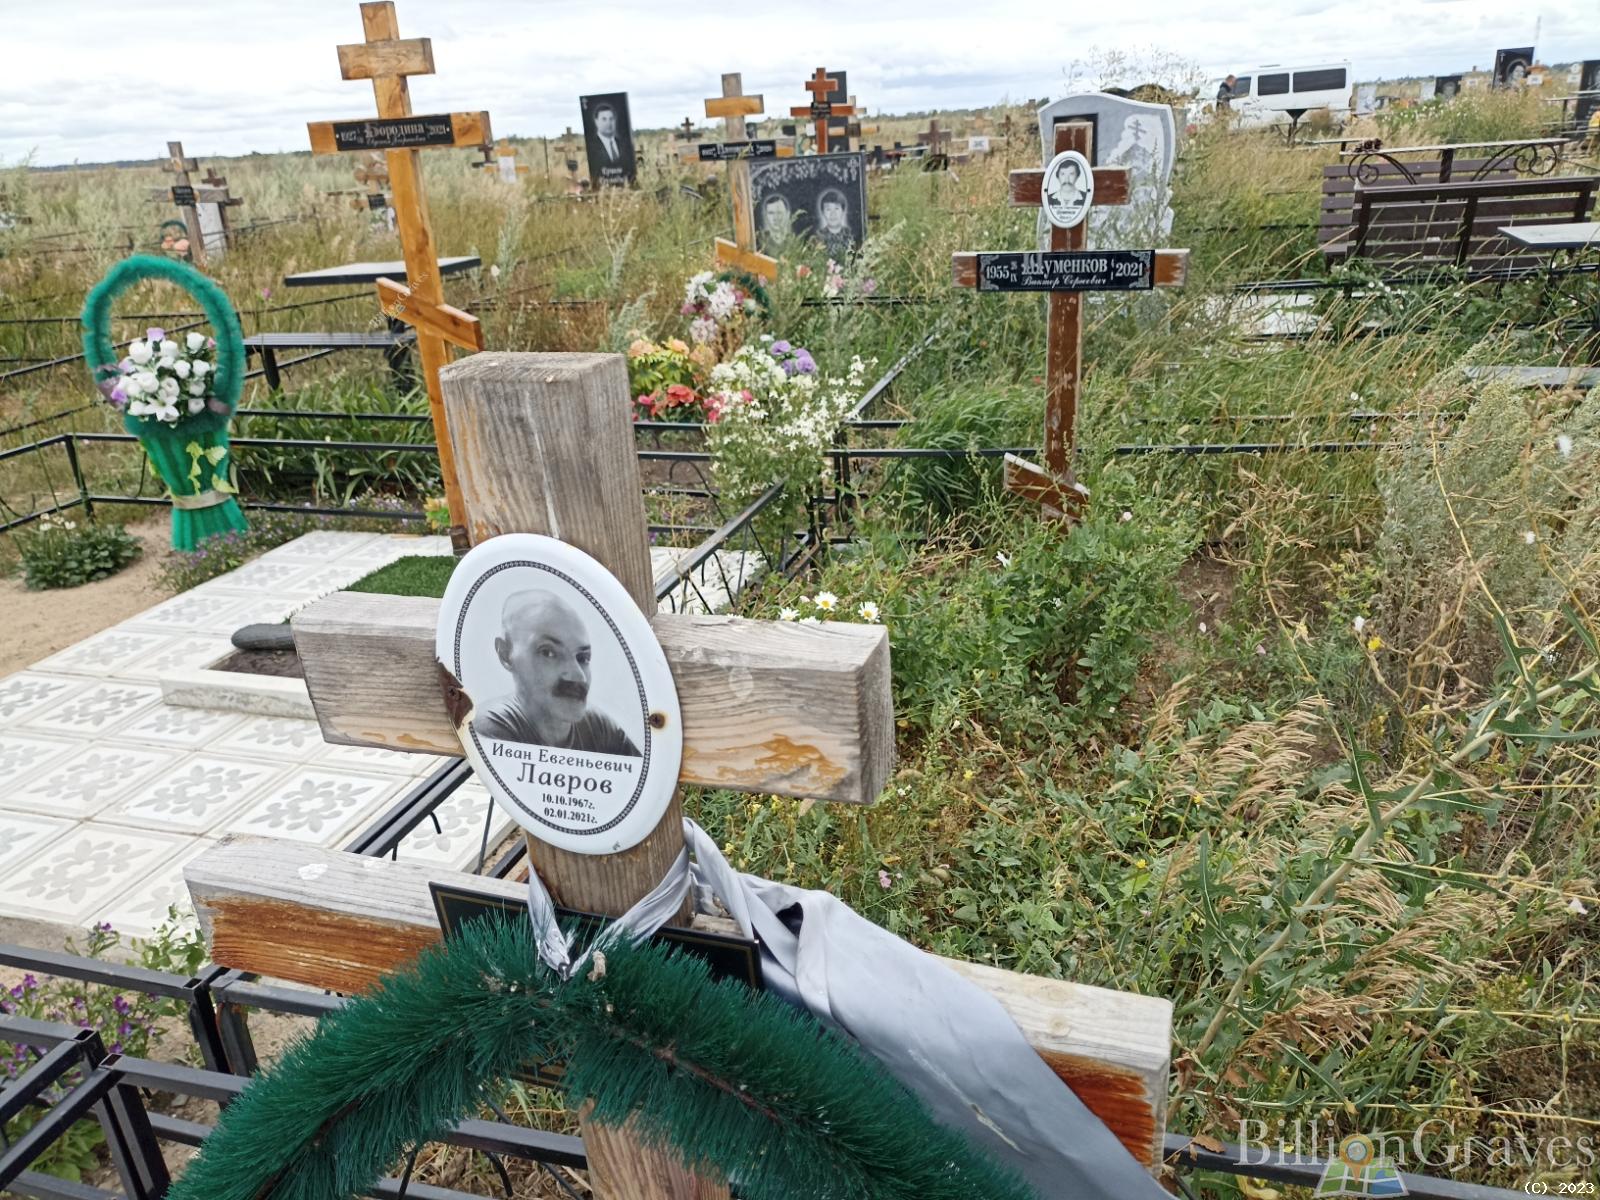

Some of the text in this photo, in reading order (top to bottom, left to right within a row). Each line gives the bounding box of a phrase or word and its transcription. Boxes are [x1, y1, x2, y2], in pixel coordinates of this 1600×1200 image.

[985, 252, 1144, 281] 1955 Шуменков 2021
[1021, 275, 1061, 289] Виктор
[492, 741, 633, 774] Иван Евгеньевич
[516, 762, 613, 794] Лавров
[541, 792, 596, 810] 10.10.1967г.
[543, 807, 598, 824] 02.01.2021г.
